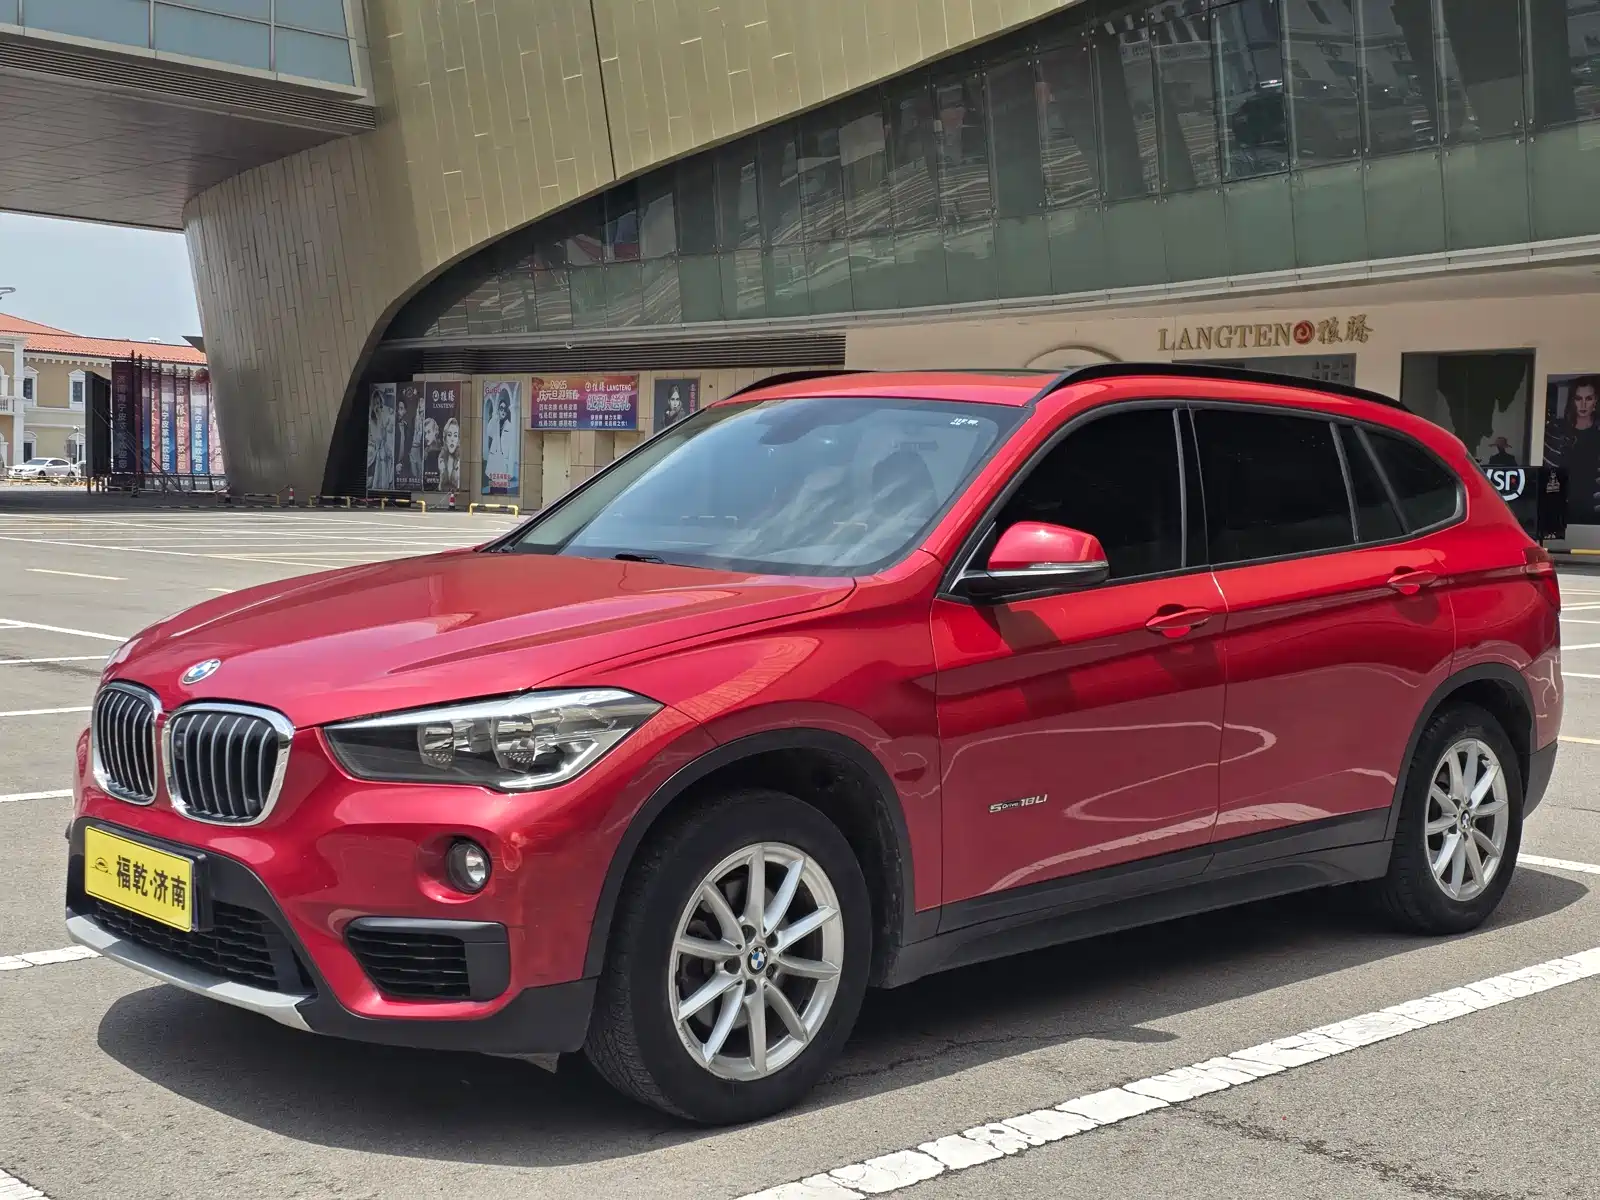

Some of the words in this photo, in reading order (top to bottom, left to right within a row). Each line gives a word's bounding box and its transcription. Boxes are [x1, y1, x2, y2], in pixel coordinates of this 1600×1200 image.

[606, 384, 632, 392] LANGTENG
[116, 855, 187, 911] 福乾·济南
